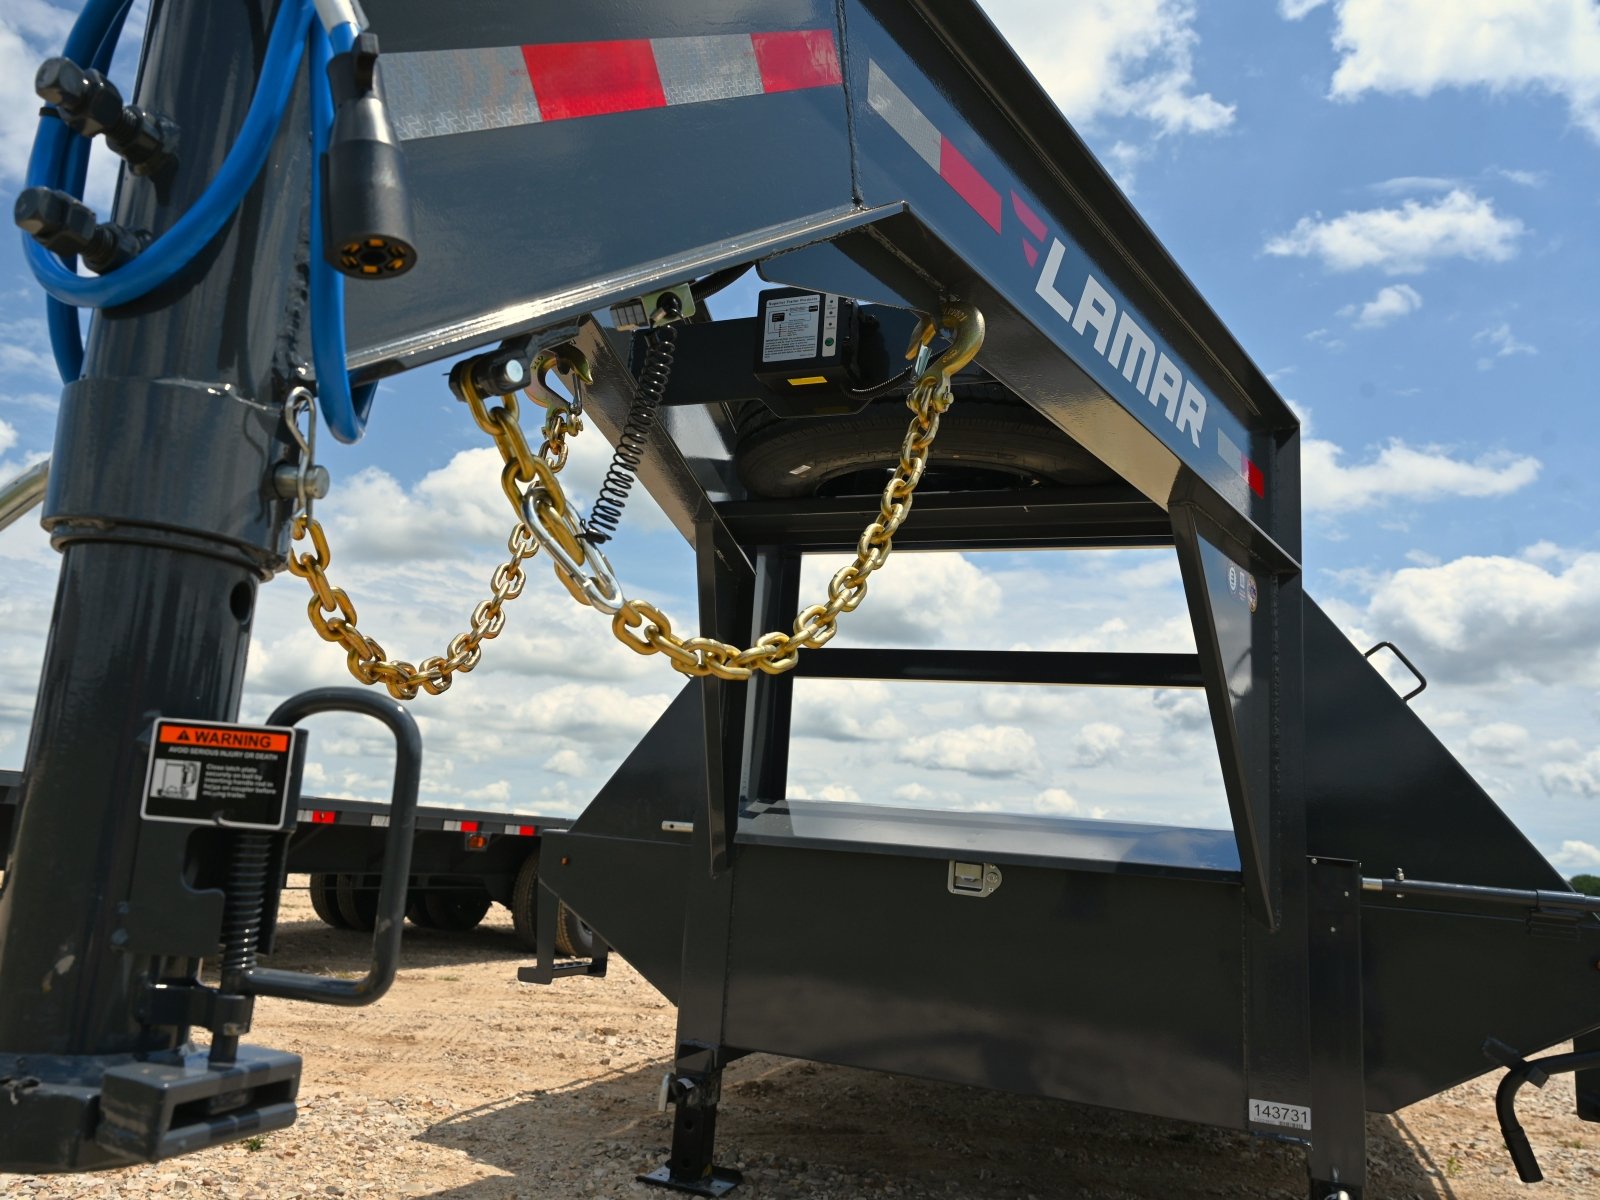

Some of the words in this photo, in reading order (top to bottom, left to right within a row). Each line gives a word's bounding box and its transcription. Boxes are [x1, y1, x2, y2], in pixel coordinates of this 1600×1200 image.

[1035, 237, 1207, 448] LAMAR
[195, 731, 271, 748] WARNING
[168, 746, 189, 754] AVOID
[190, 747, 218, 756] SERIOUS
[219, 749, 243, 758] INJURY
[244, 751, 254, 759] OR
[255, 752, 278, 760] DEATH
[206, 763, 224, 771] Close
[1254, 1103, 1307, 1123] 143731
